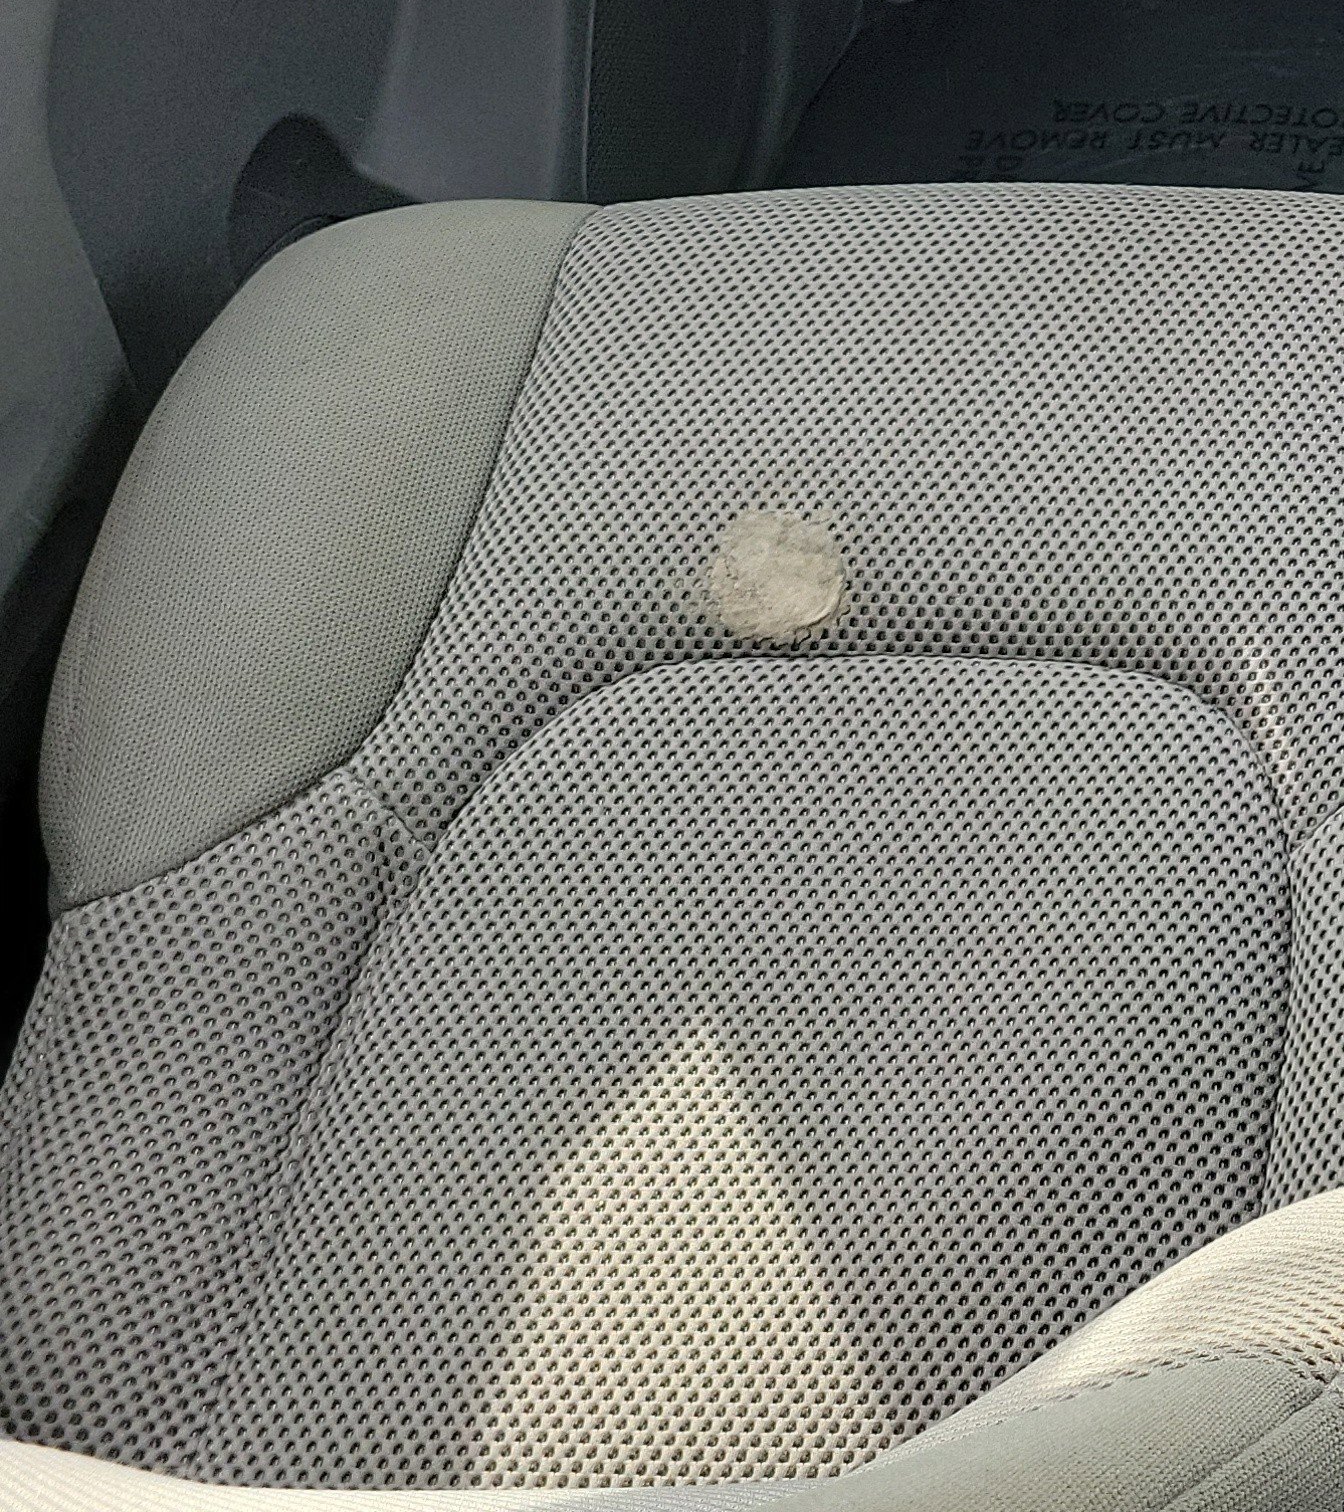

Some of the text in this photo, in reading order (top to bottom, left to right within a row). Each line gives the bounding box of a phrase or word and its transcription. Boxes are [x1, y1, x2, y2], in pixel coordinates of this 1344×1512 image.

[1053, 98, 1166, 126] COVER
[965, 128, 1108, 152] REMOVE
[1127, 128, 1227, 151] MUST
